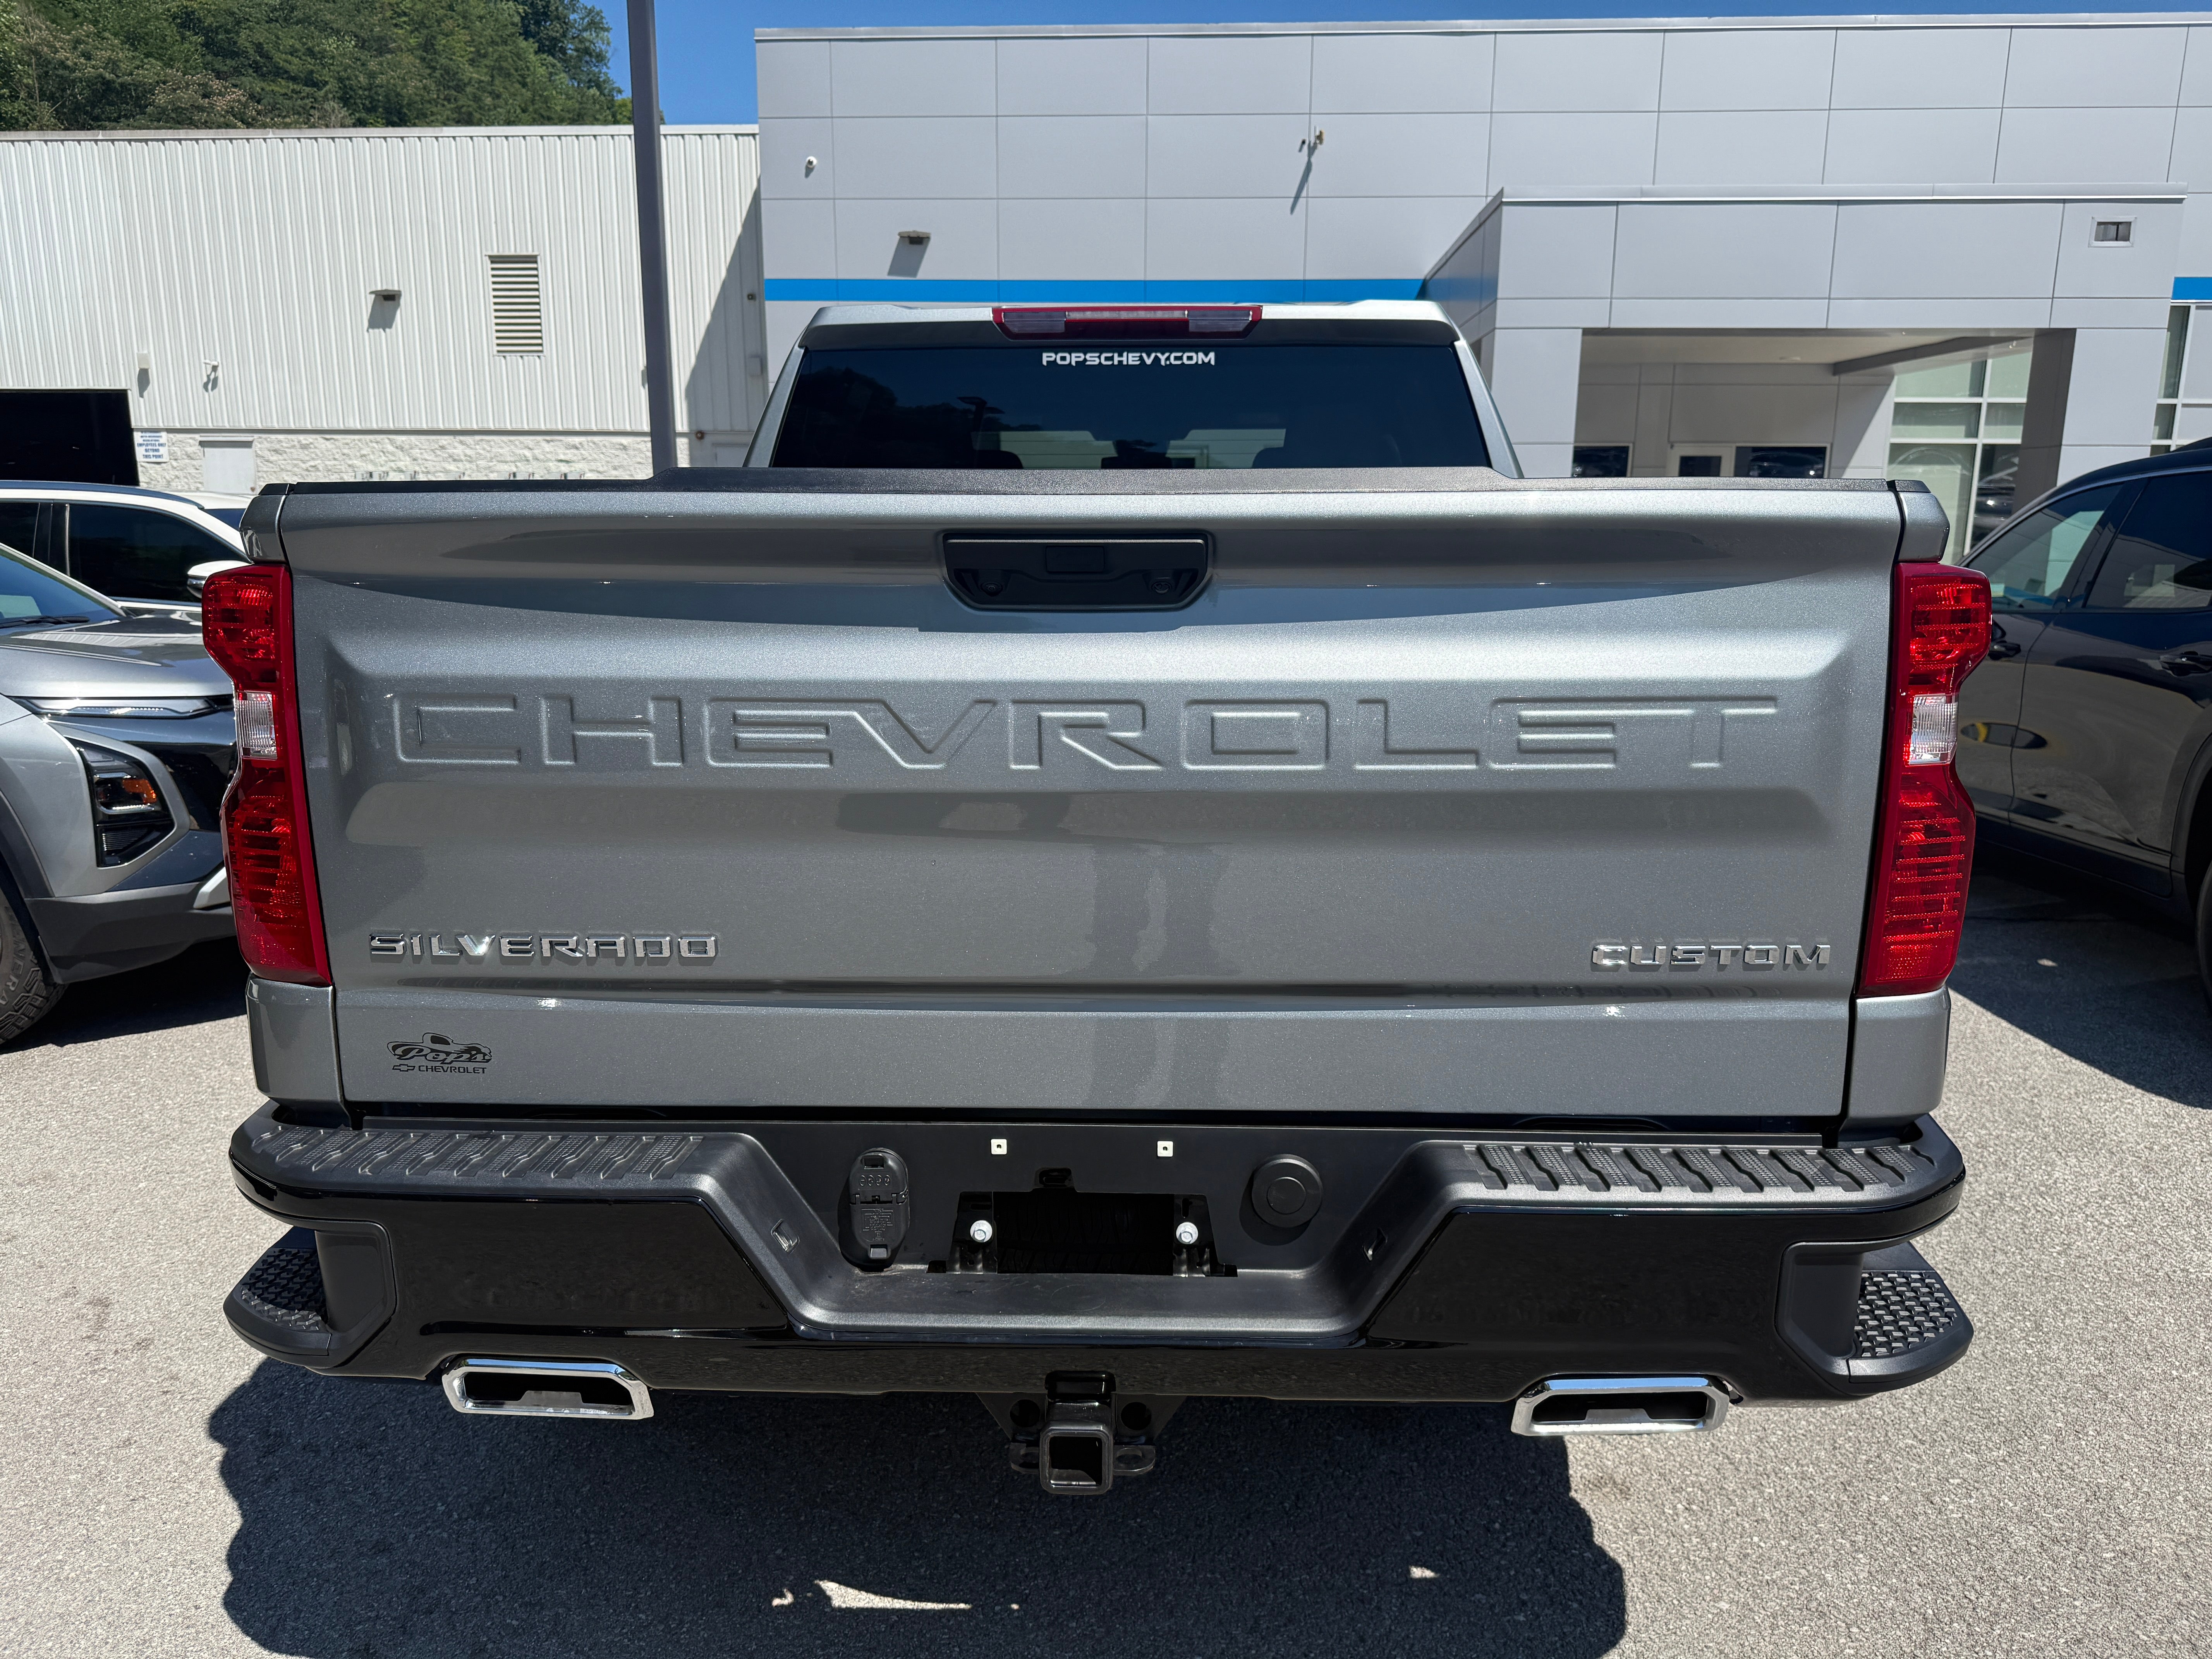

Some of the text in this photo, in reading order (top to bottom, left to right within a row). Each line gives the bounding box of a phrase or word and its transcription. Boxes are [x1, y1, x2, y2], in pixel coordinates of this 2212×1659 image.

[1042, 352, 1216, 366] POPSCHEVY.COM
[393, 694, 1778, 770] CHEVROLET
[369, 933, 719, 958] SILVERADO
[1591, 944, 1832, 965] CUSTOM
[418, 1065, 487, 1074] CHEVROLET
